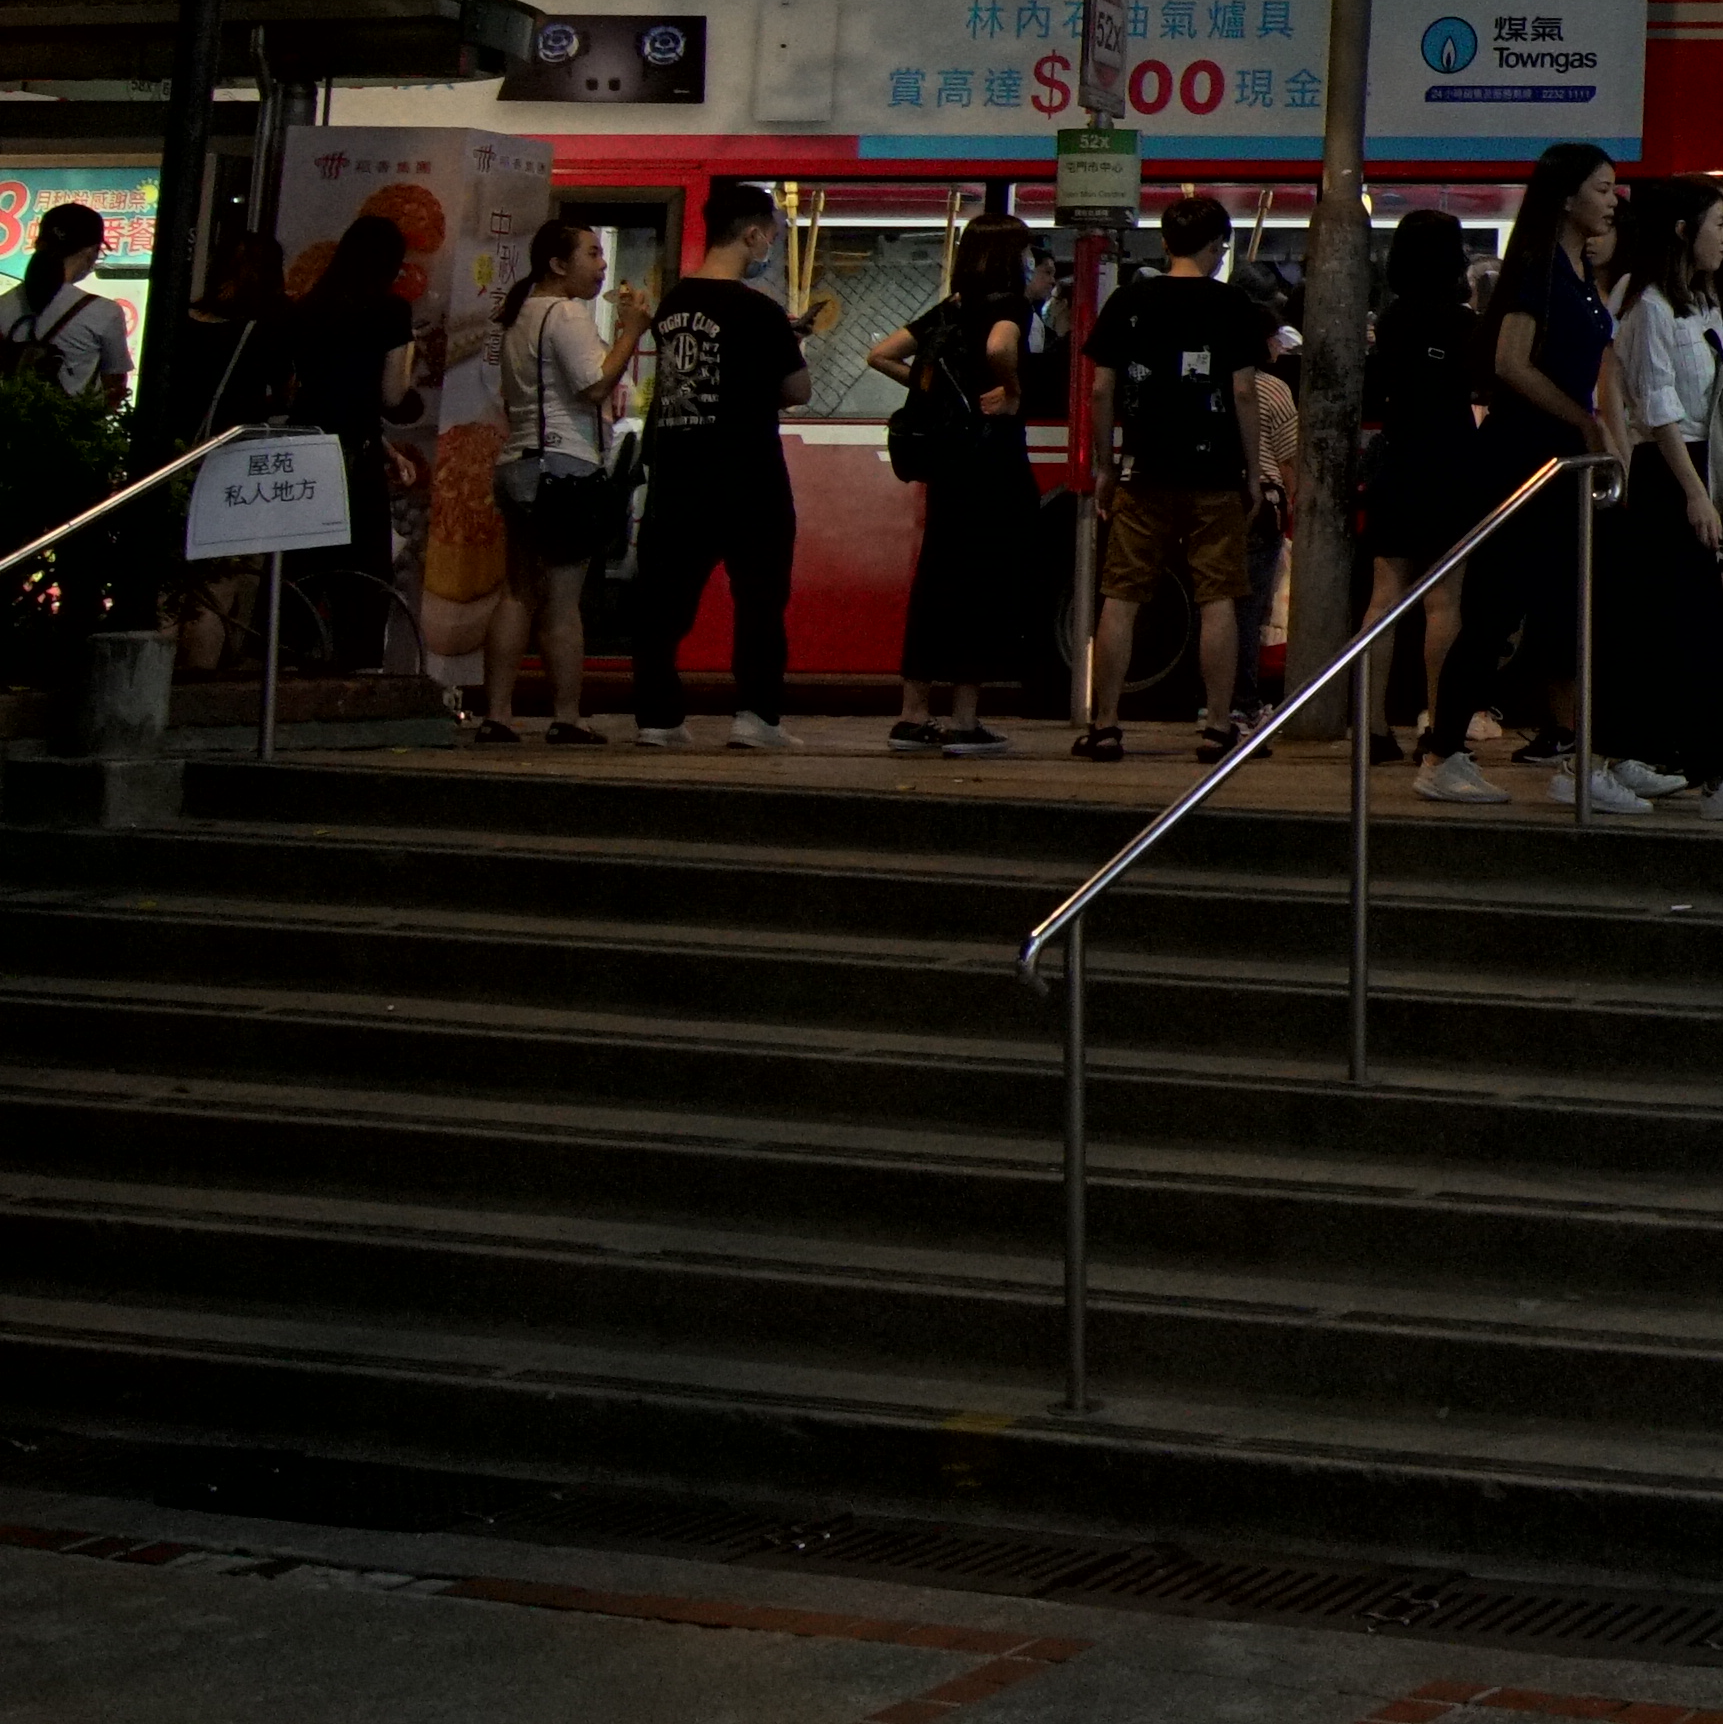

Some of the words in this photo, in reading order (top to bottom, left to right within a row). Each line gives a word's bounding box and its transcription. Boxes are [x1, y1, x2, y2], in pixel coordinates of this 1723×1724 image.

[1494, 16, 1564, 42] 煤氣
[1493, 47, 1597, 74] Towngas
[1031, 50, 1225, 119] $00
[1234, 68, 1323, 109] 現金
[692, 311, 721, 339] CLUB
[247, 452, 293, 477] 屋苑
[224, 478, 317, 508] 私人地方
